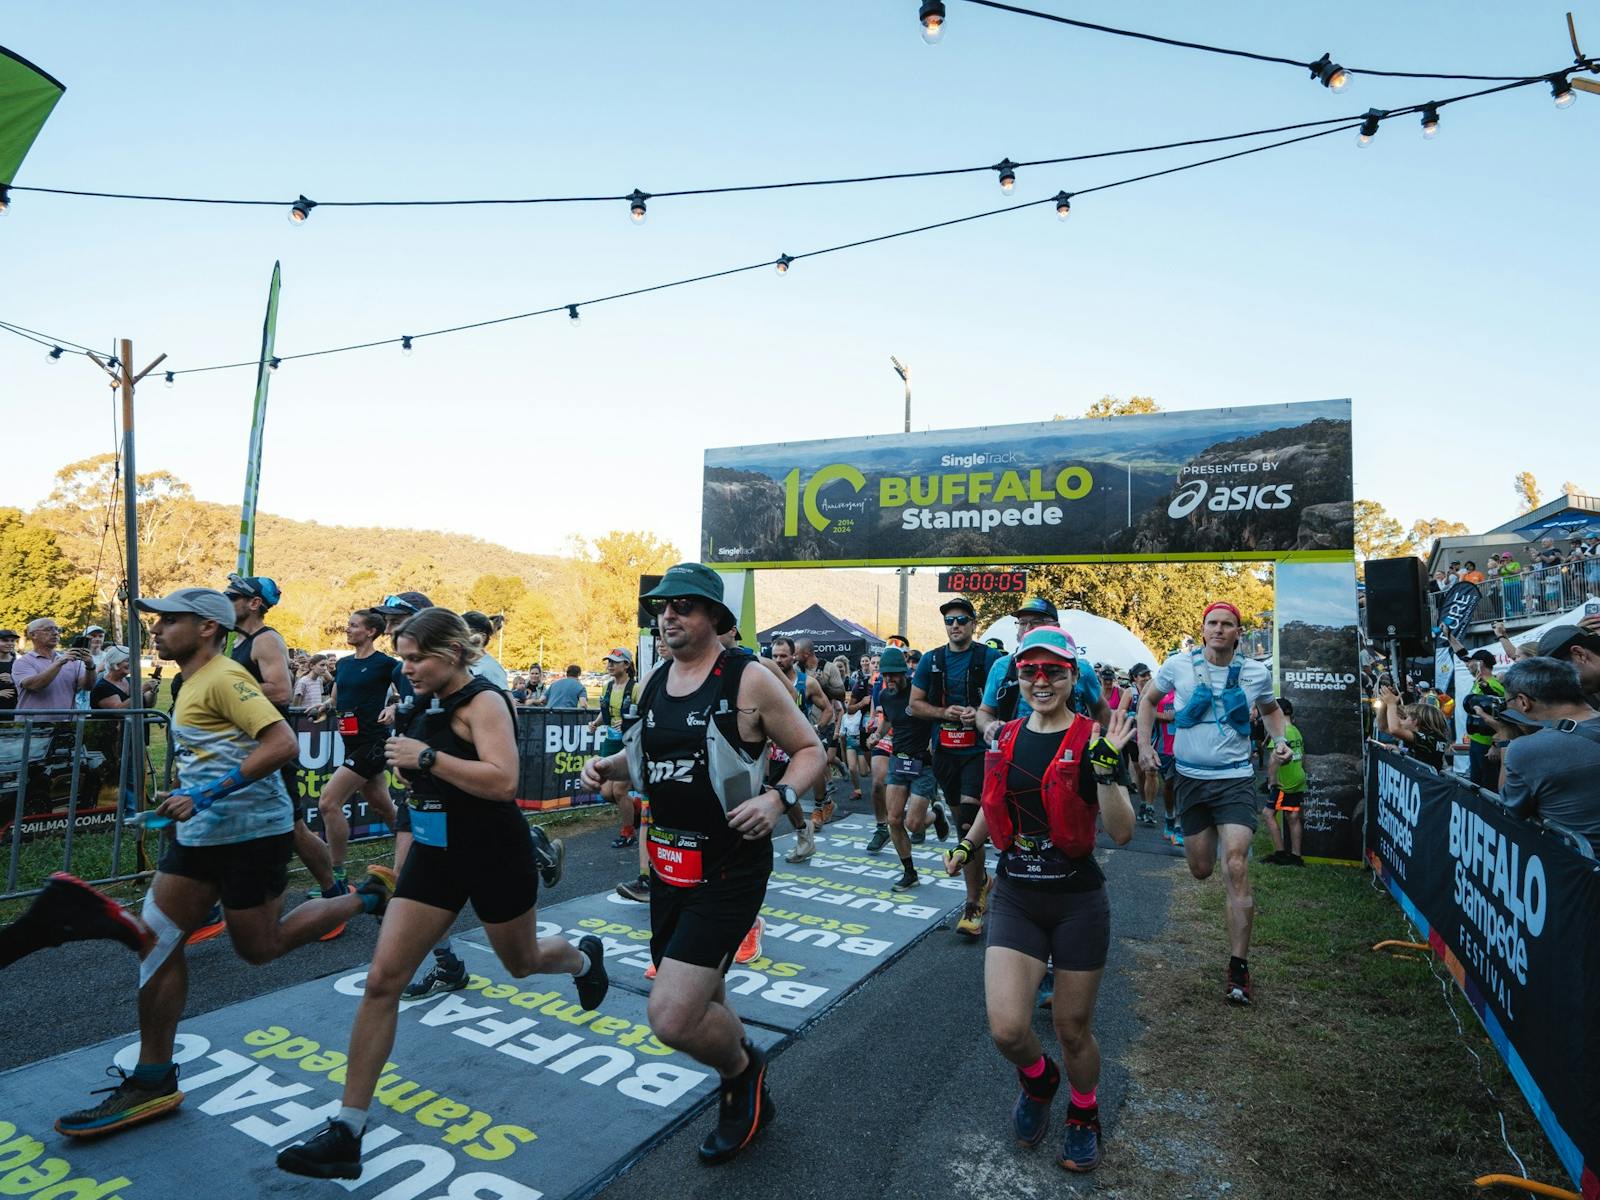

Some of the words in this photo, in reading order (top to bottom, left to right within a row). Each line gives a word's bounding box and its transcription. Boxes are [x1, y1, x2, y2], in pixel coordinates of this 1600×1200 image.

[941, 452, 1017, 468] SingleTrack
[1183, 463, 1258, 475] PRESENTED
[1262, 462, 1279, 471] BY
[879, 466, 1094, 508] BUFFALO
[901, 502, 1063, 532] Stampede
[947, 573, 1024, 591] 18:00:05
[1285, 671, 1356, 684] BUFFALO
[1293, 681, 1347, 691] Stampede
[545, 724, 608, 753] BUFF
[1378, 759, 1421, 828] BUFFALO
[1378, 797, 1413, 857] Stampede
[657, 847, 682, 864] BRYAN
[1380, 836, 1407, 881] FESTIVAL
[1449, 801, 1547, 938] BUFFALO
[1454, 860, 1529, 986] Stampede
[1459, 924, 1514, 1021] FESTIVAL
